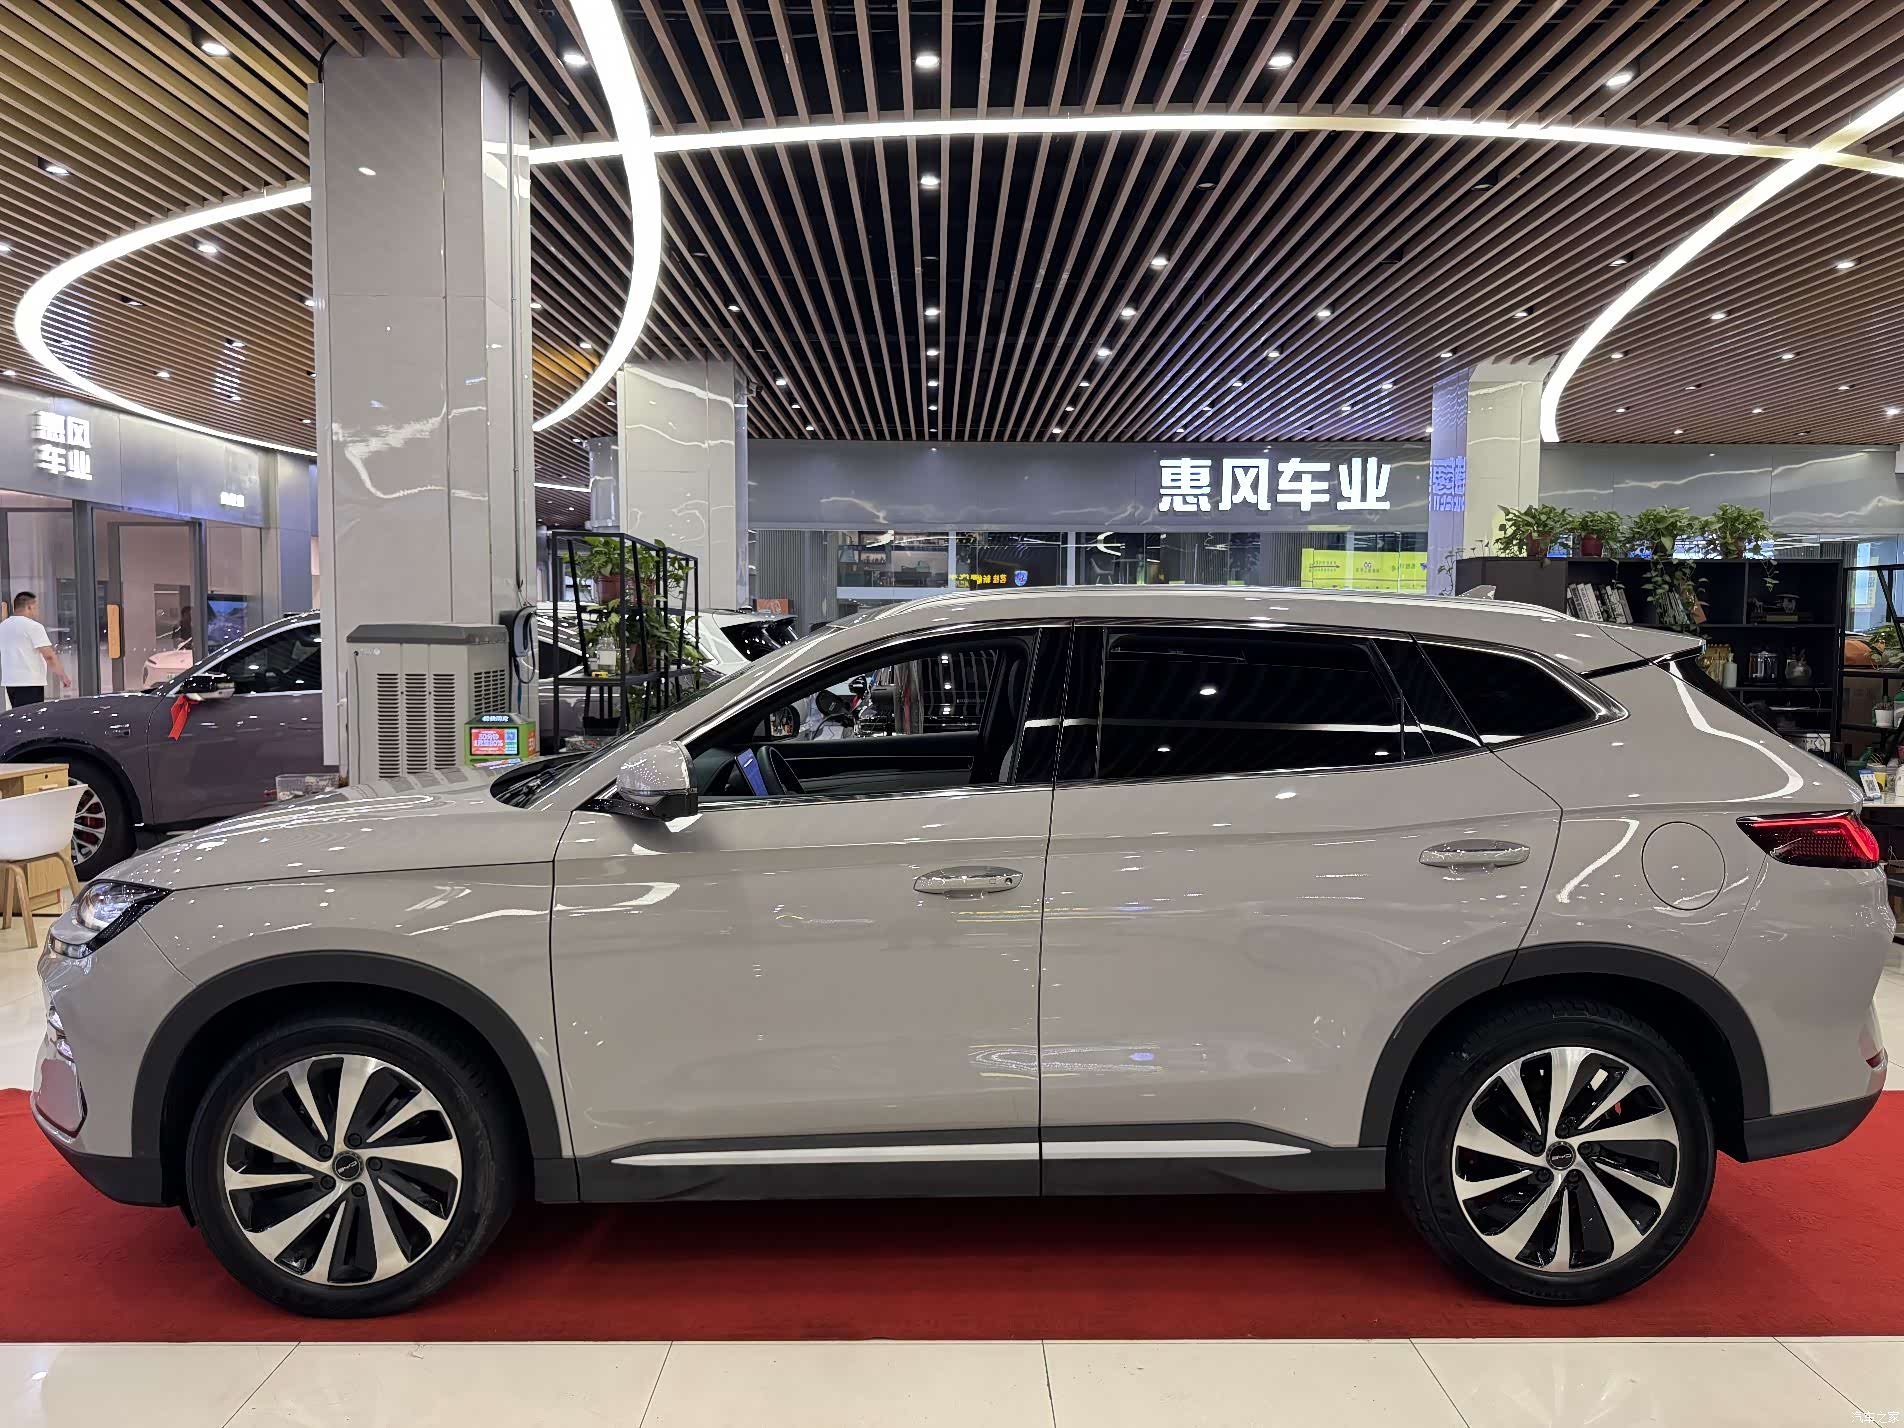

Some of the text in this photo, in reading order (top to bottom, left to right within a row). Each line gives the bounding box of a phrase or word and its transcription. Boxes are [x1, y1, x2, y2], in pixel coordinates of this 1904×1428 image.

[34, 444, 93, 480] 车业
[1158, 457, 1392, 512] 惠风车业
